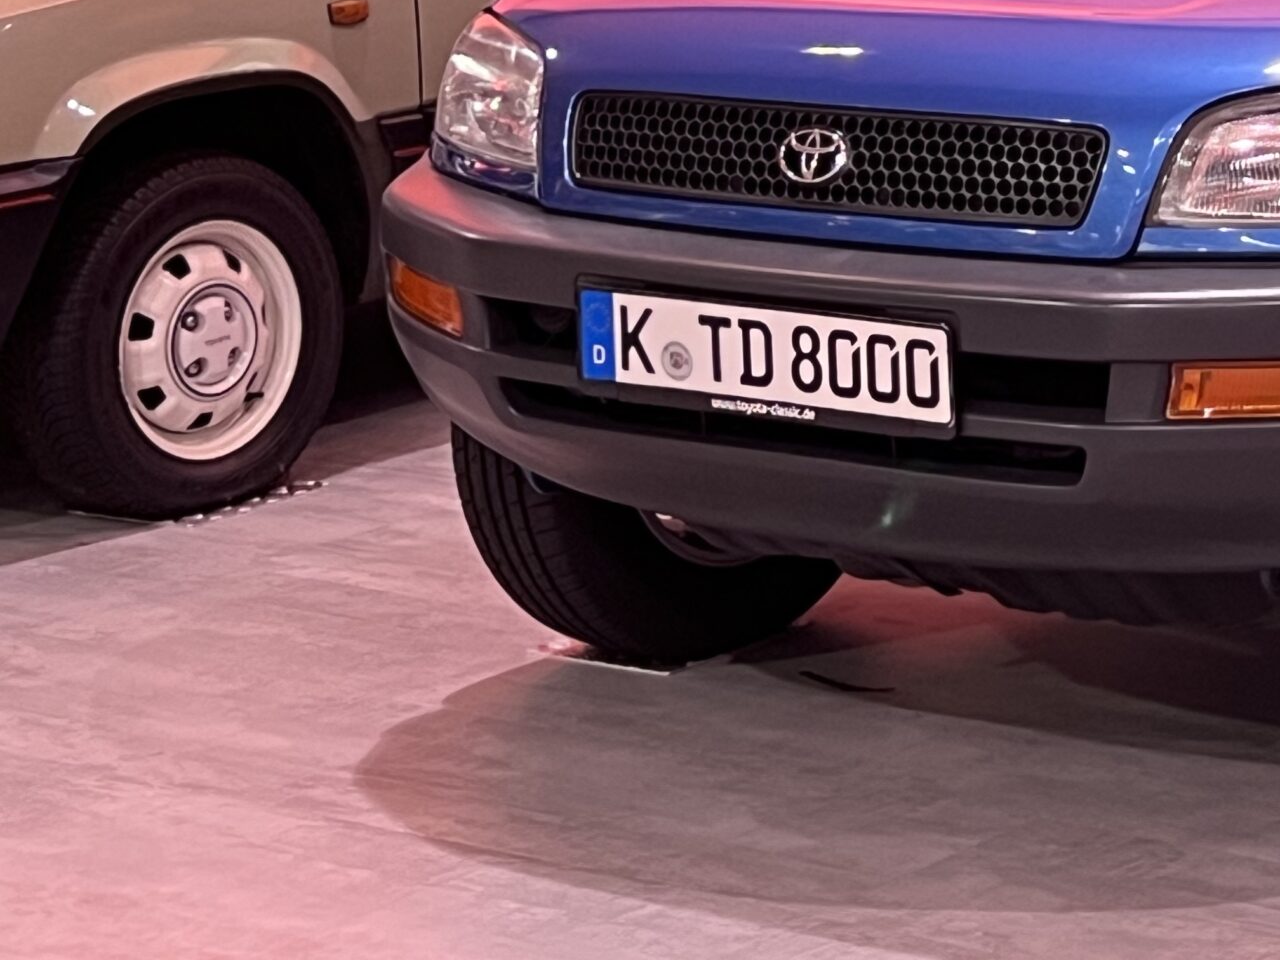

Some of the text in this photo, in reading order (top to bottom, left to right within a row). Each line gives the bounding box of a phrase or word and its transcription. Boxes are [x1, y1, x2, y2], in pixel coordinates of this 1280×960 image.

[593, 344, 605, 364] D
[619, 304, 940, 410] K TD 8000
